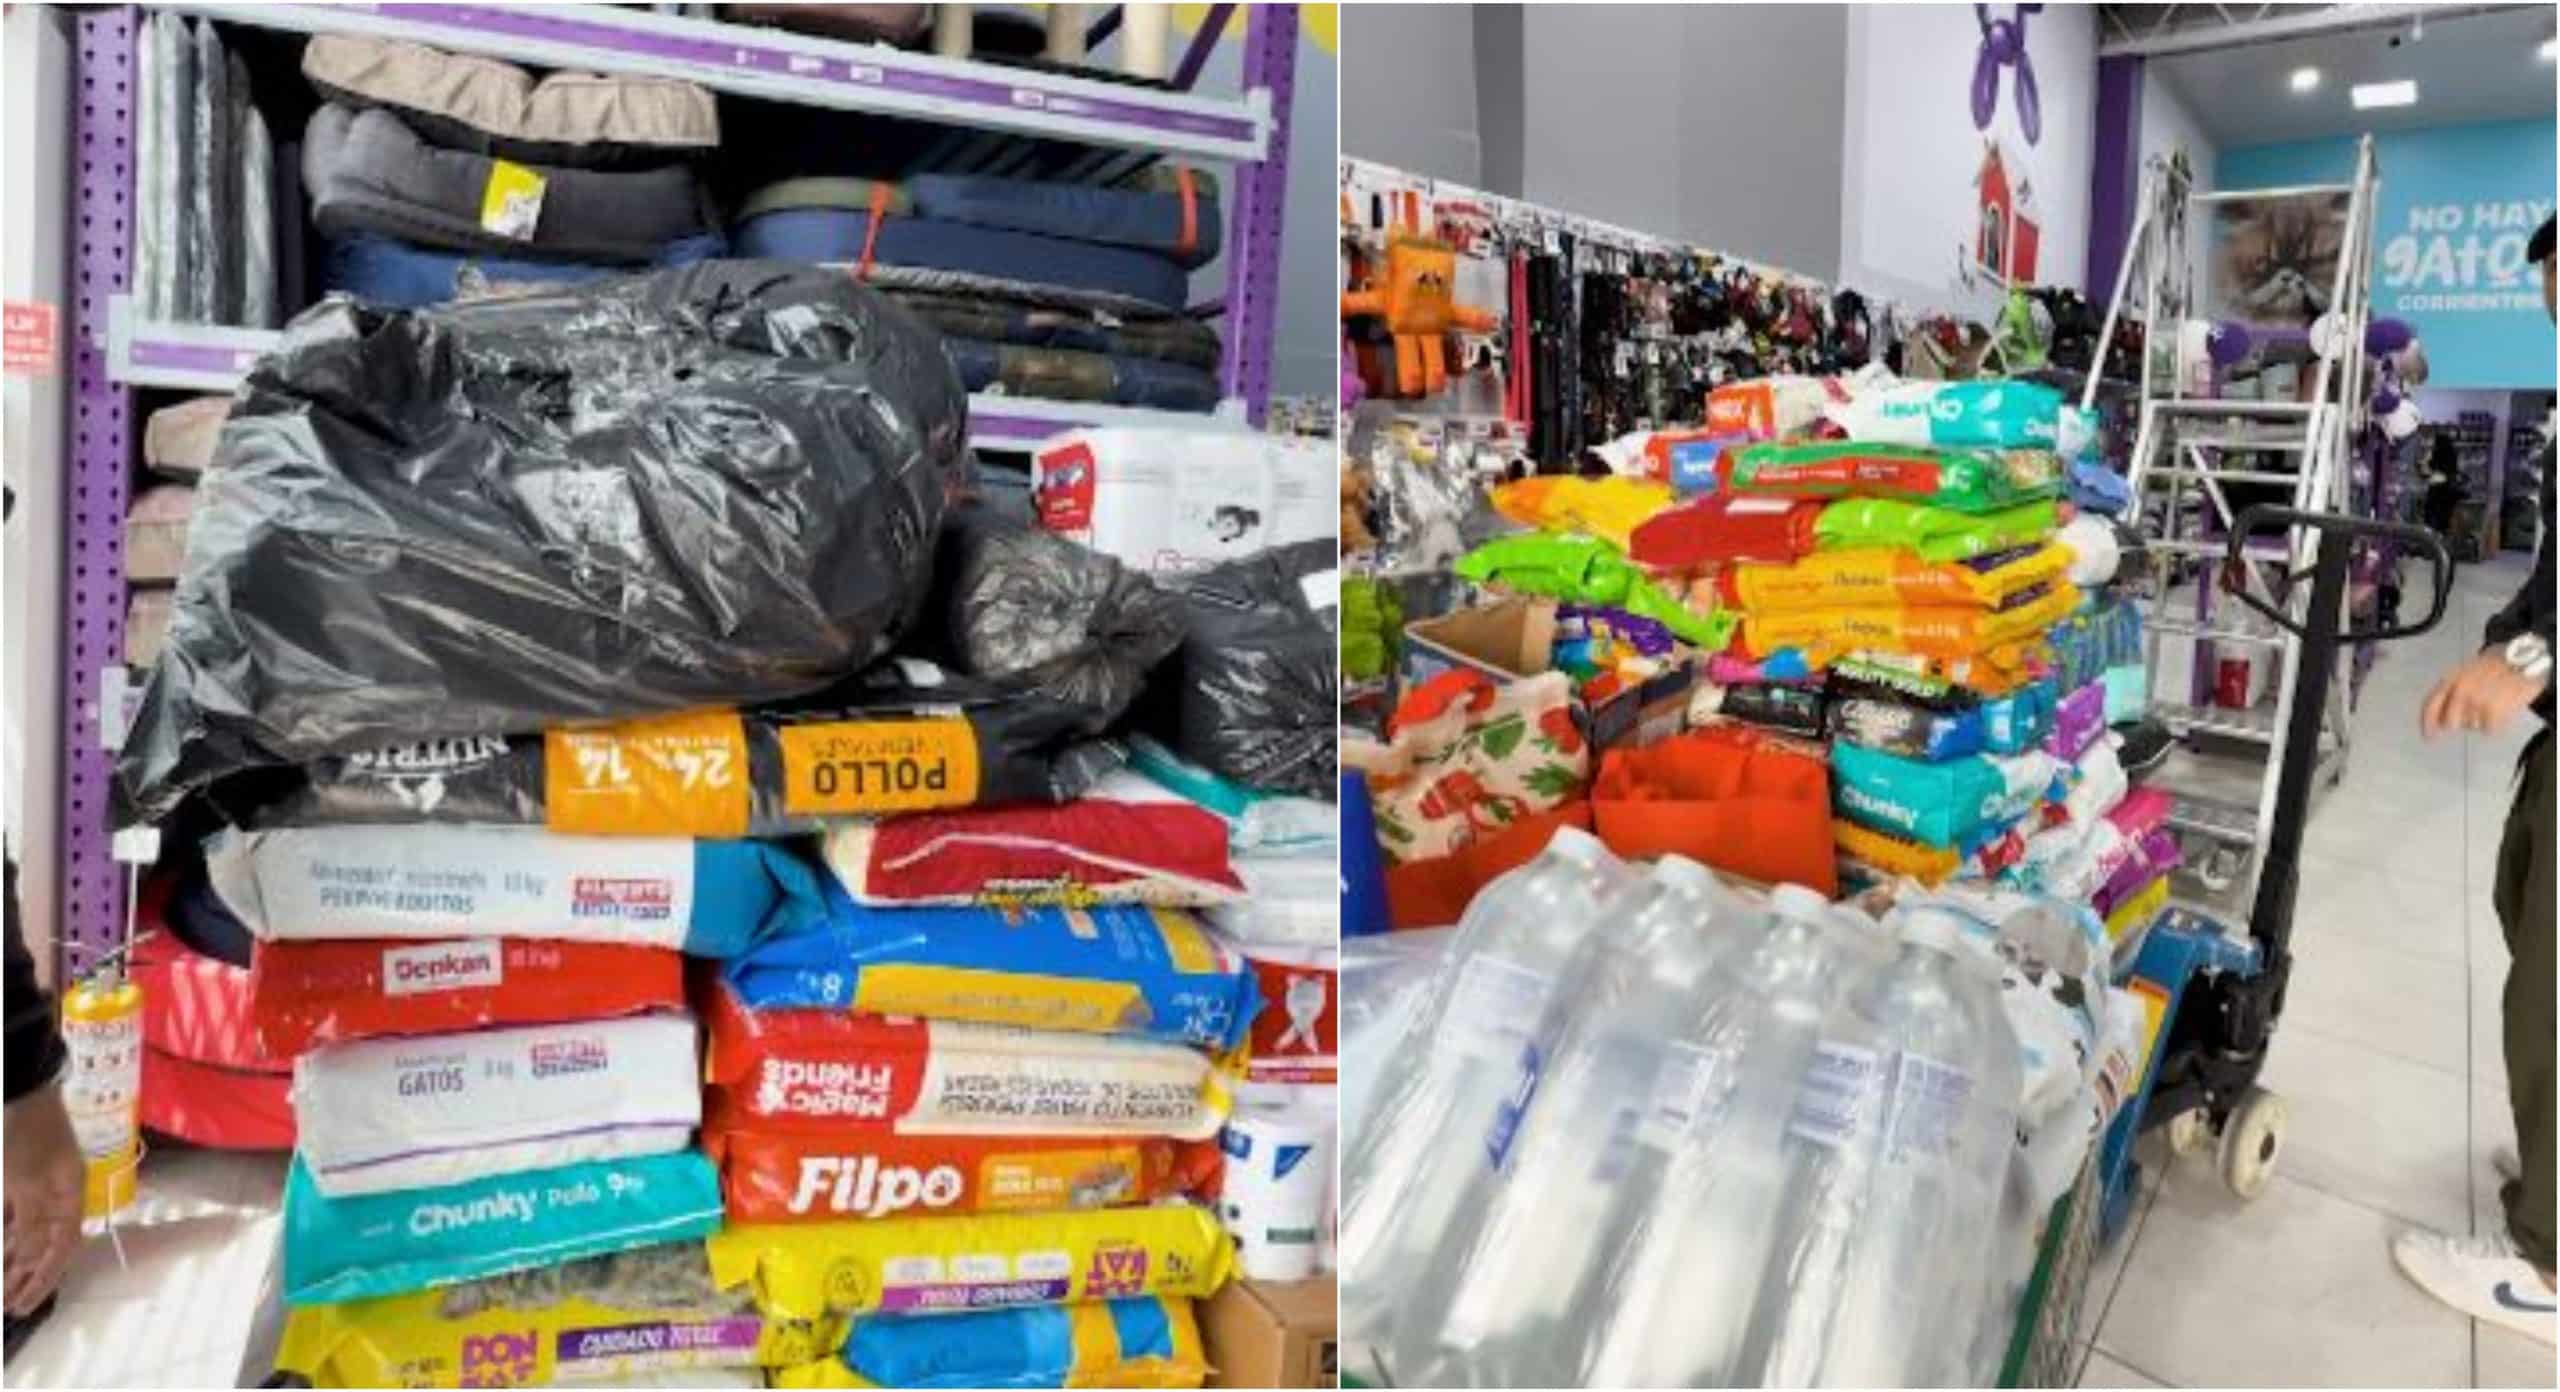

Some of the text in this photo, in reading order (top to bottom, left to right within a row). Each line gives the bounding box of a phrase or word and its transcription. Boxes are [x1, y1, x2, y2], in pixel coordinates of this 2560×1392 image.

[2409, 198, 2550, 232] NO HAY
[814, 757, 946, 795] POLLO
[821, 972, 842, 1000] 8
[398, 1066, 464, 1097] GATOS
[762, 1058, 892, 1094] Friends
[790, 1090, 887, 1118] Magic
[787, 1155, 963, 1218] Filpo
[408, 1187, 539, 1236] Chunky
[462, 1331, 538, 1366] DON
[579, 1327, 666, 1355] CUIDADO
